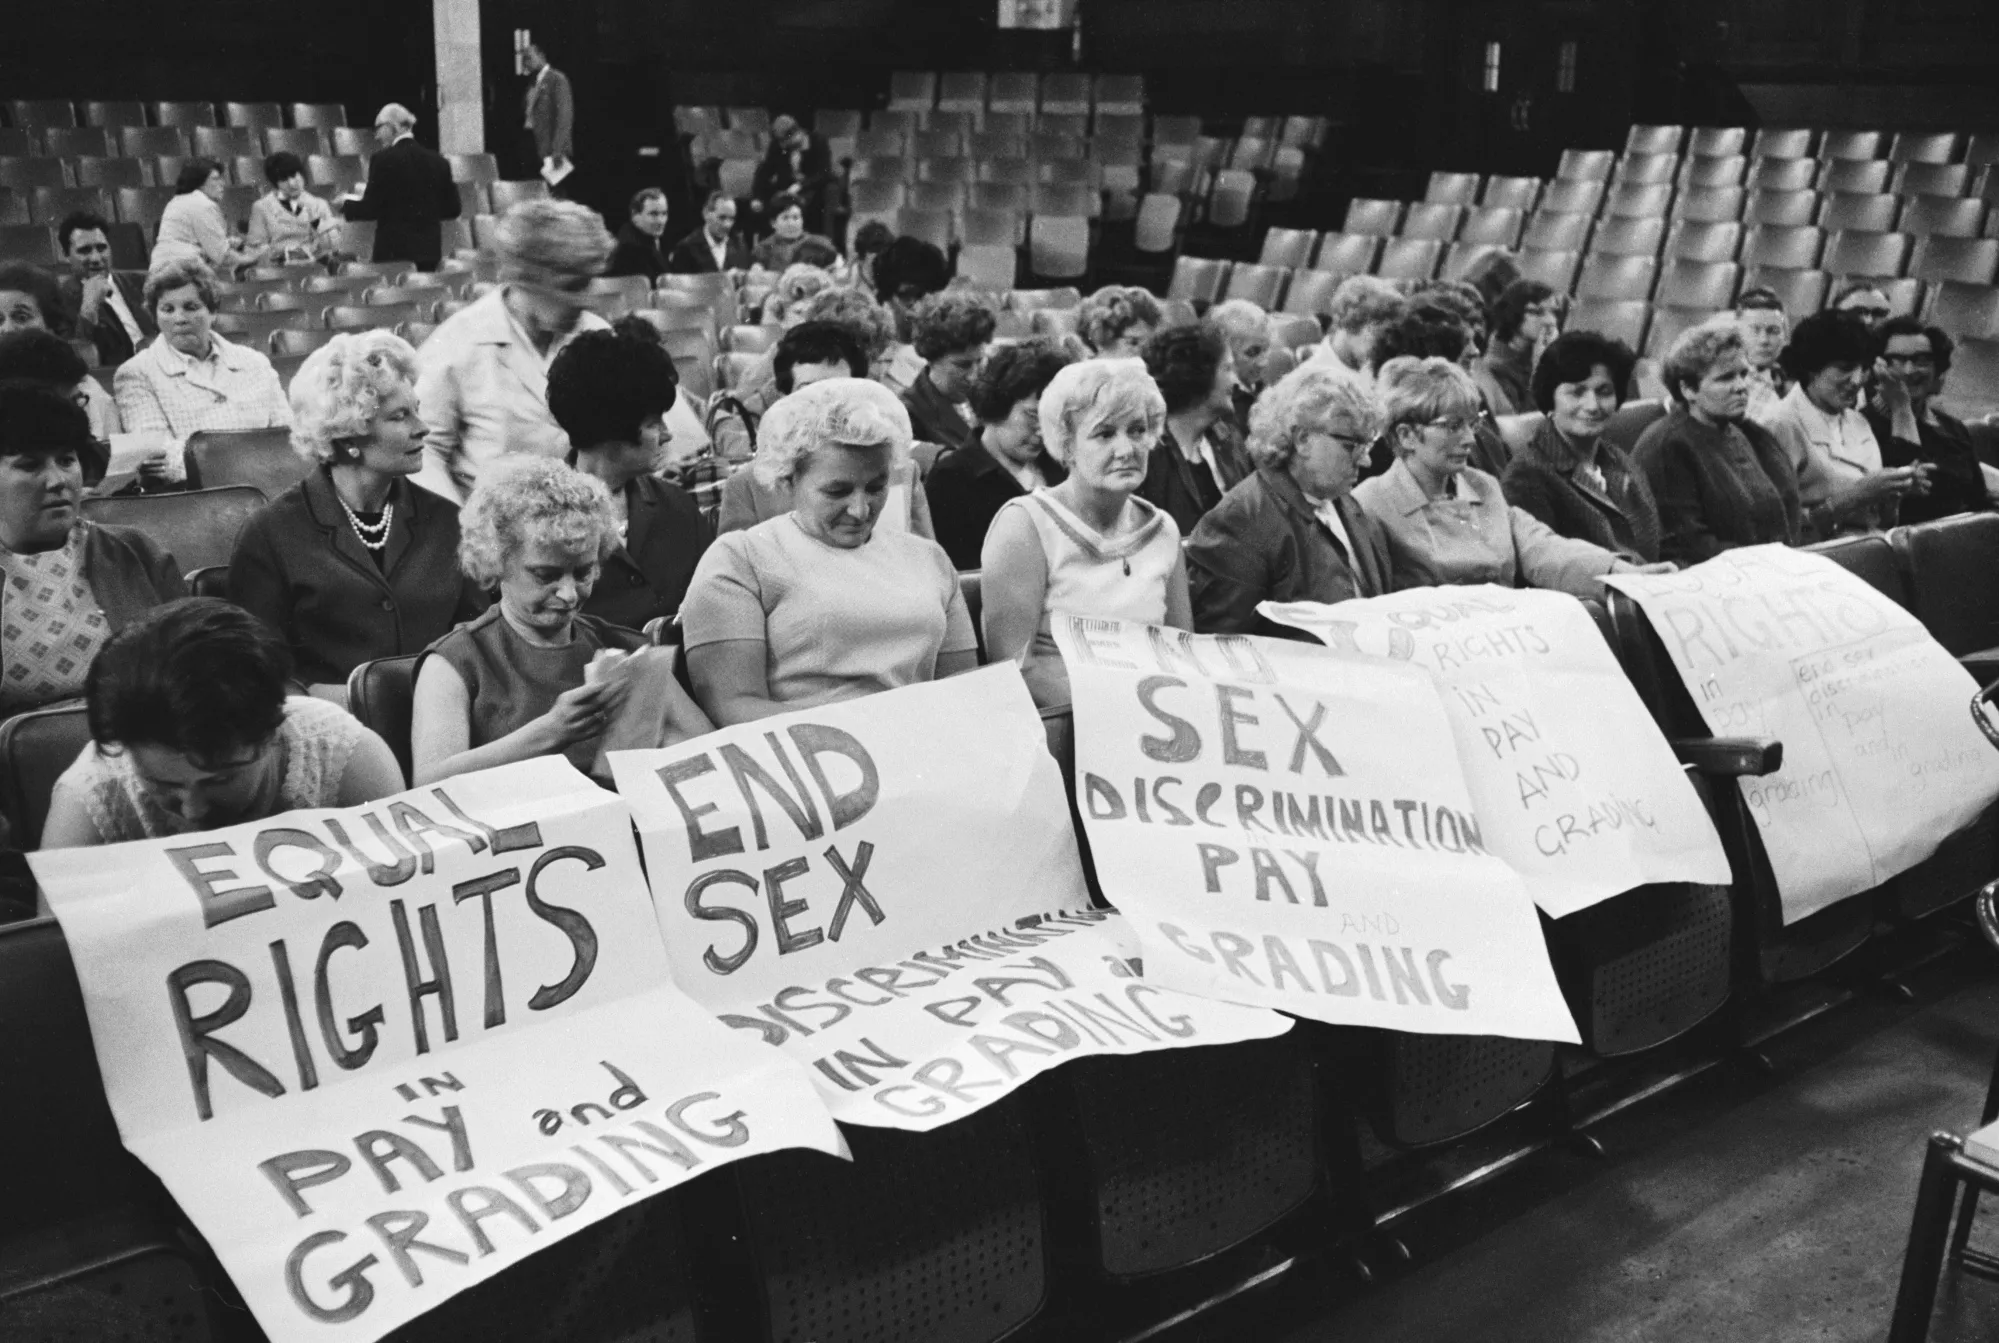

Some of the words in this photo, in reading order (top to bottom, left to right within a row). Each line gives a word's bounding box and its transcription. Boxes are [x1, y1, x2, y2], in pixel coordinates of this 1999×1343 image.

[1067, 614, 1279, 685] END
[1432, 625, 1551, 672] RIGHTS
[1135, 674, 1349, 778] SEX
[1480, 708, 1541, 760] PAY
[655, 723, 880, 863] END
[1084, 771, 1487, 857] DISCRIMINATION
[1515, 752, 1580, 809] AND
[164, 788, 543, 929] EQUAL
[1196, 842, 1329, 908] PAY
[684, 840, 886, 975] SEX
[1340, 911, 1401, 935] AND
[167, 846, 605, 1121] RIGHTS
[1157, 922, 1472, 1011] GRADING
[812, 1037, 912, 1092] IN
[924, 955, 1076, 1028] PAY
[873, 984, 1197, 1118] GRADING
[395, 1071, 466, 1102] IN
[257, 1105, 475, 1219] PAY
[531, 1060, 650, 1137] and
[284, 1092, 751, 1325] GRADING
